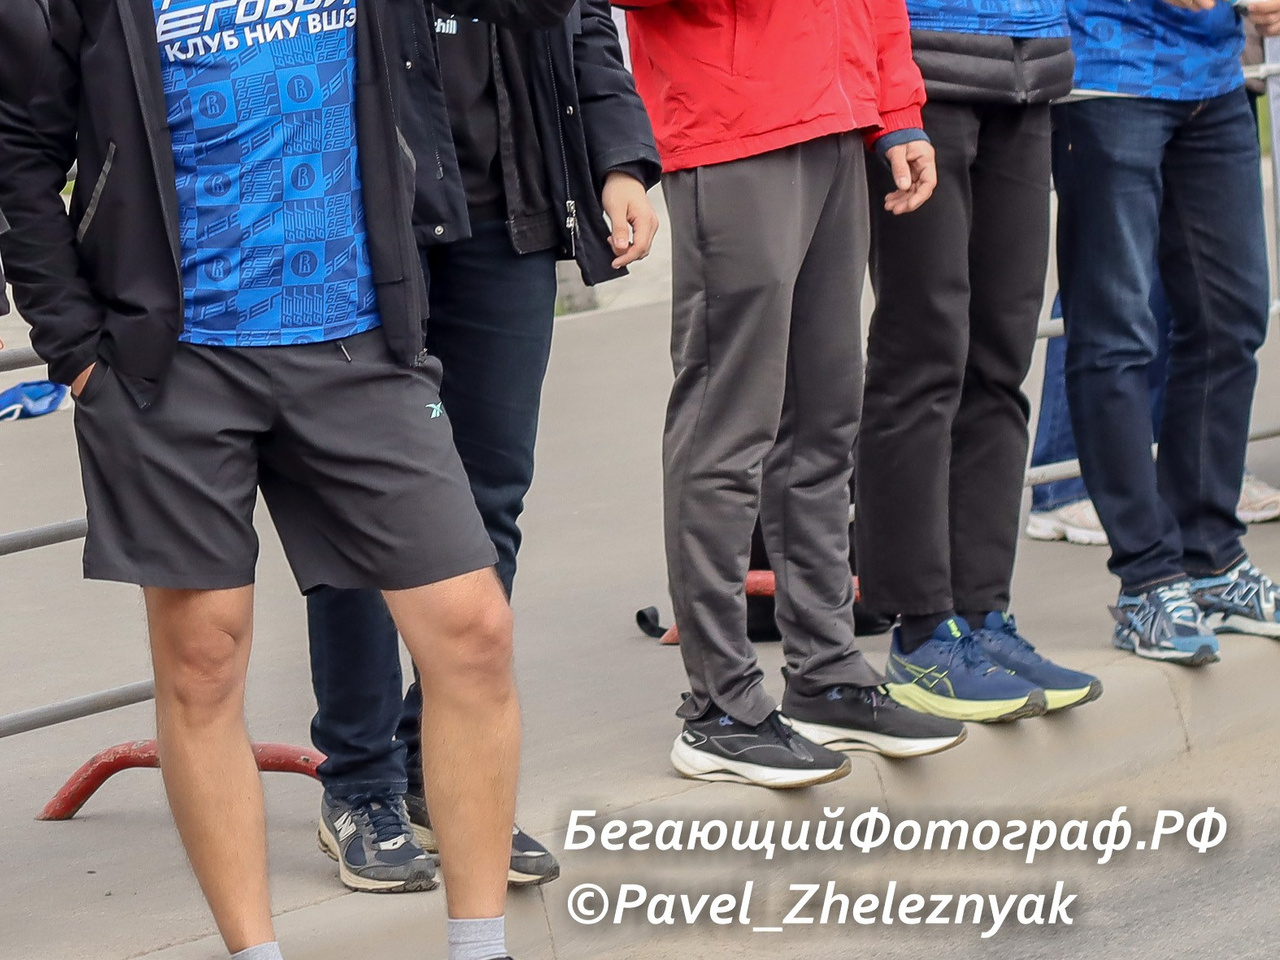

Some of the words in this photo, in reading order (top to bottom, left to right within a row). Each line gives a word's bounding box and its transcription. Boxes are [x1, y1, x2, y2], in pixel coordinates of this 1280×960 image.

[165, 29, 239, 62] КЛУБ
[244, 16, 301, 47] НИУ
[308, 7, 357, 35] ВШЭ
